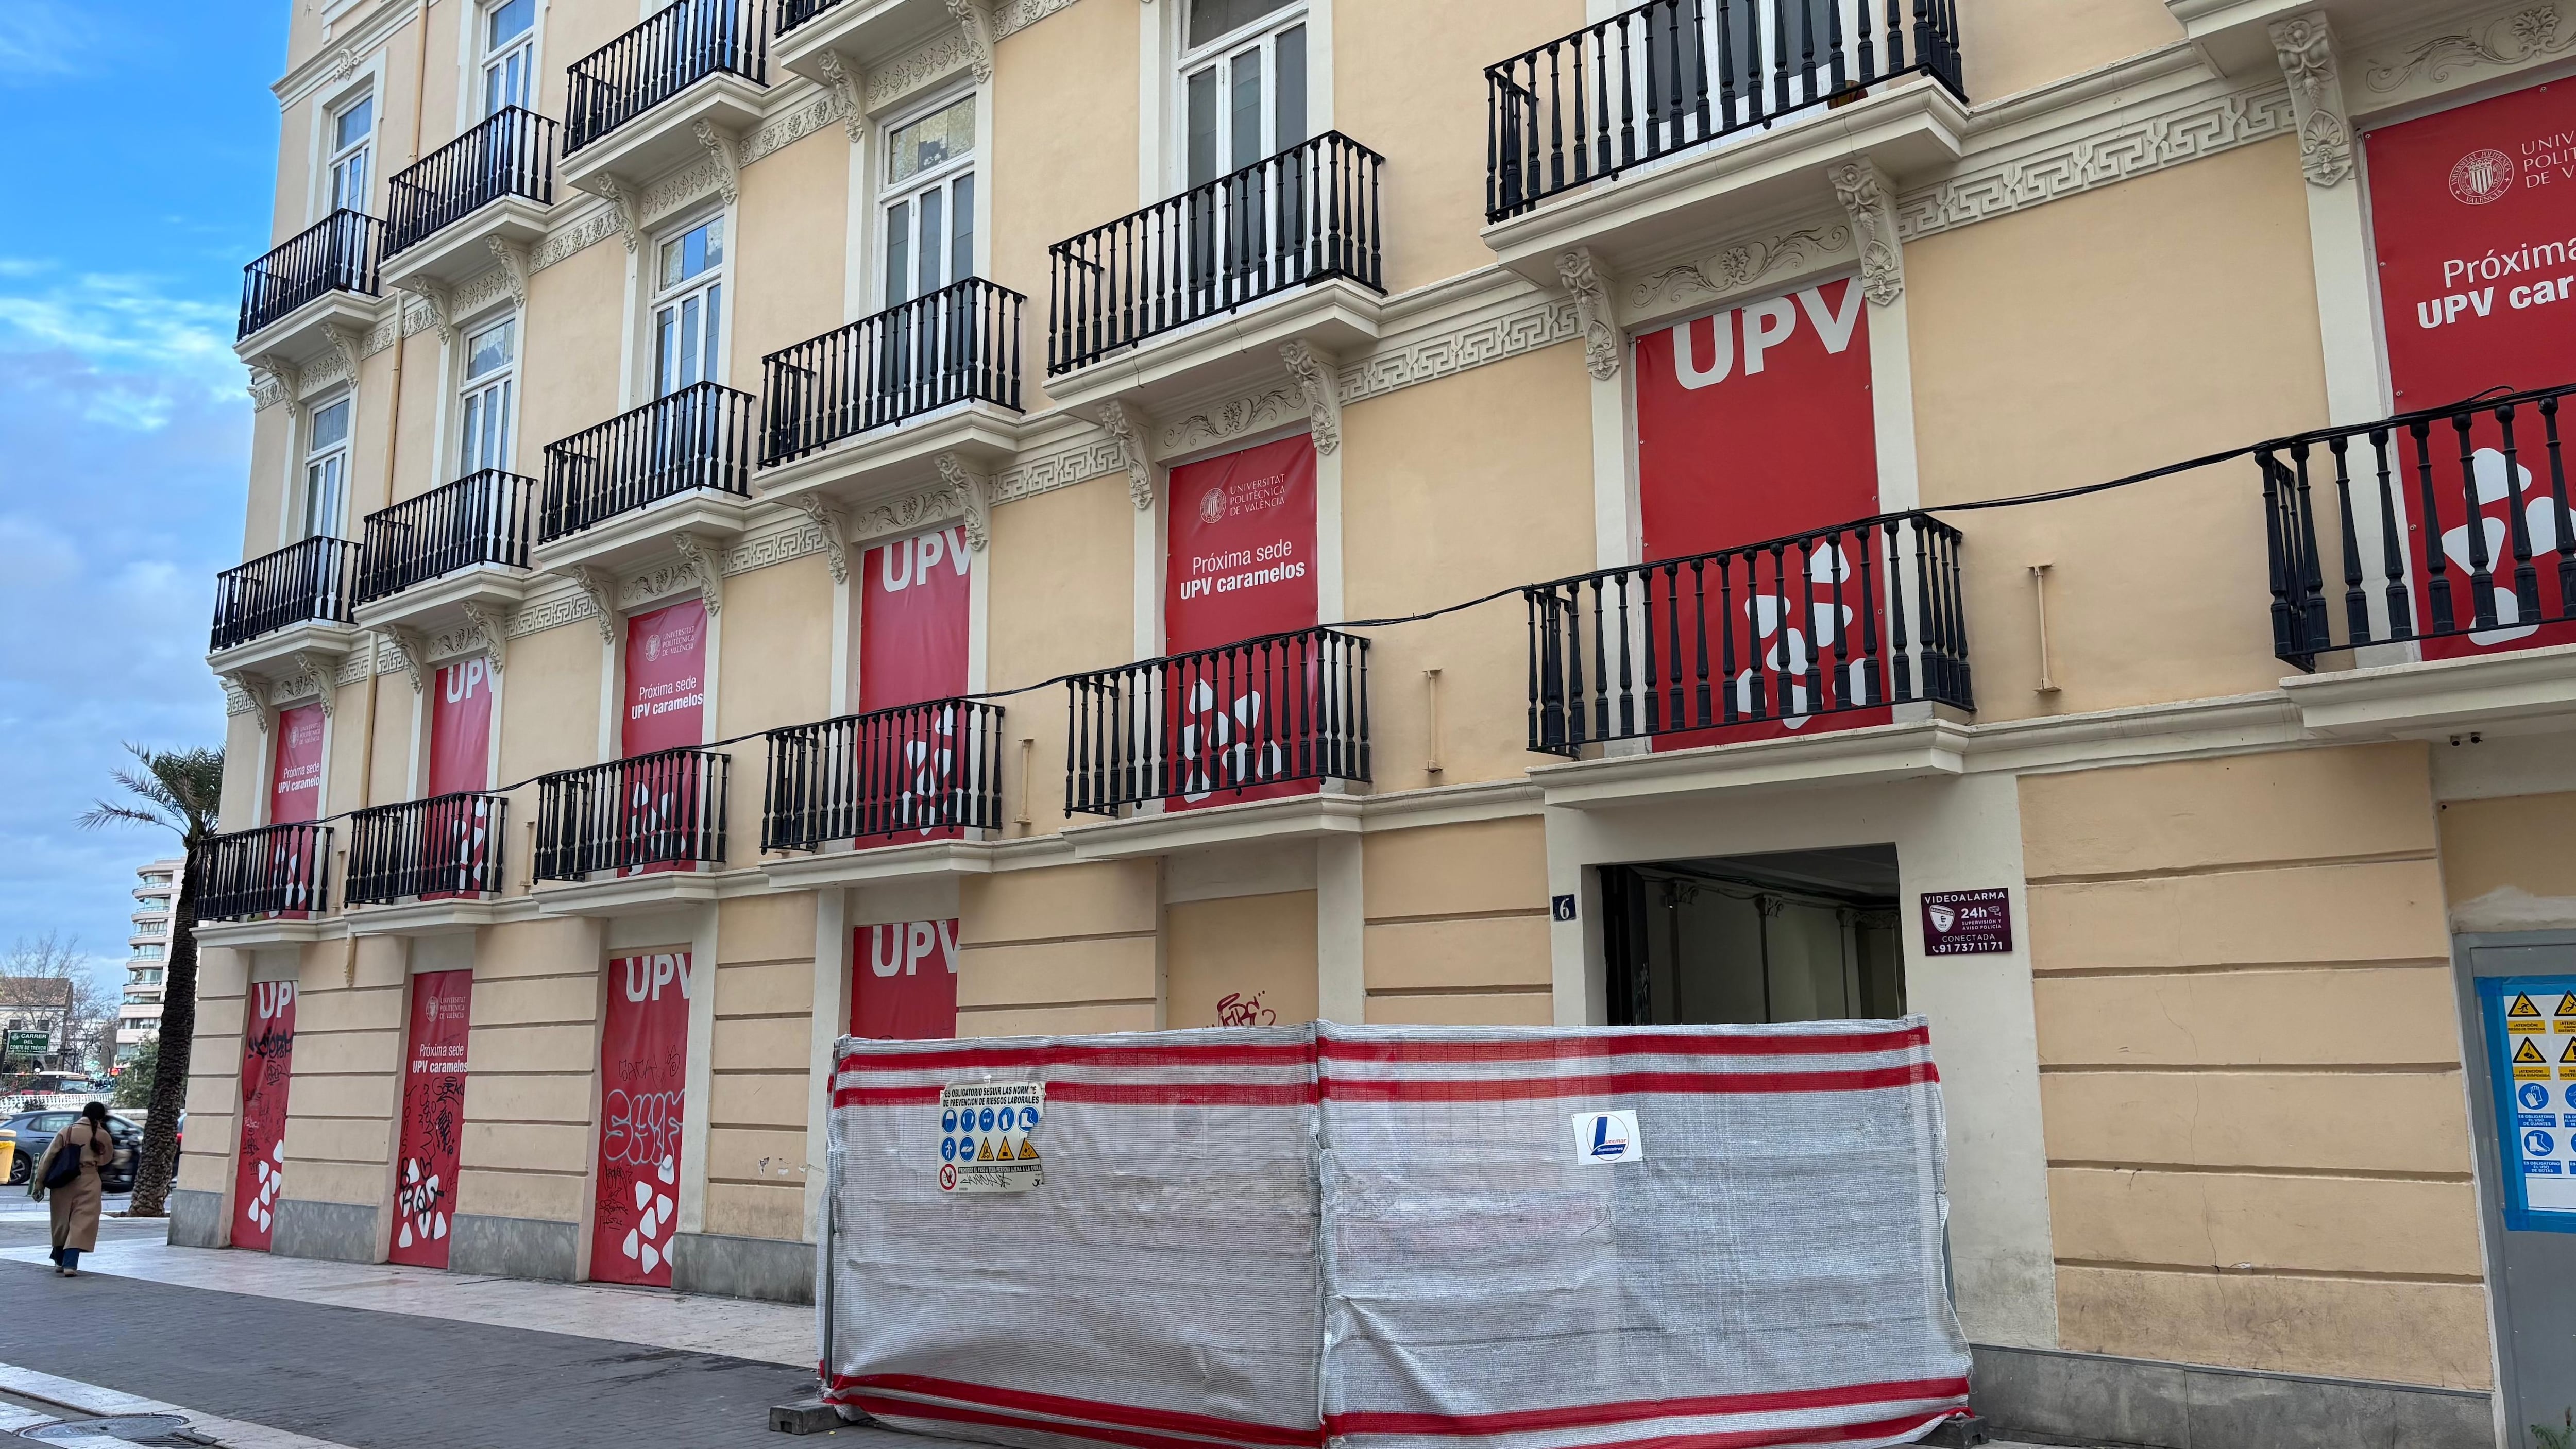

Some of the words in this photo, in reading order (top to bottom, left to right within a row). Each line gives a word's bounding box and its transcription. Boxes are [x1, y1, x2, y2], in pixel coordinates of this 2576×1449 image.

[2521, 130, 2574, 155] UNIV
[2526, 171, 2551, 189] DE
[2417, 286, 2494, 329] UPV
[2509, 275, 2574, 309] car
[1673, 278, 1865, 390] UPV
[1230, 473, 1285, 495] UNIVERSITAT
[1230, 485, 1285, 505] POLITÈCNICA
[1230, 506, 1240, 516] DE
[1245, 496, 1284, 513] VALÈNCIA
[883, 528, 971, 592] UPV
[1193, 550, 1251, 575] Próxima
[1256, 539, 1292, 561] sede
[1180, 577, 1212, 600] UPV
[1217, 561, 1305, 592] caramelos
[663, 626, 694, 640] UNIVERSITAT
[639, 683, 673, 701] Próxima
[675, 675, 697, 691] sede
[632, 703, 651, 720] UPV
[653, 693, 704, 715] caramelos
[284, 765, 305, 779] Próxima
[307, 761, 320, 774] sede
[278, 780, 291, 793] UPV
[1925, 891, 2005, 904] VIDEOALARMA
[1560, 898, 1569, 919] 6
[1961, 907, 1987, 919] 24h
[1939, 944, 1952, 953] 91
[1954, 943, 1974, 952] 737
[1978, 942, 1987, 951] 11
[1991, 942, 2003, 950] 71
[1942, 934, 1995, 942] CONECTADA
[872, 920, 961, 977] UPV
[259, 981, 298, 1019] UP
[419, 1043, 447, 1057] Próxima
[449, 1043, 464, 1056] sede
[413, 1060, 428, 1073] UPV
[943, 1099, 949, 1107] DE
[950, 1098, 978, 1107] PREVENCION
[979, 1097, 985, 1105] DE
[986, 1096, 1007, 1105] RIESGOS
[1008, 1096, 1039, 1104] LABORALES
[952, 1088, 982, 1097] OBLIGATORIO
[984, 1087, 1001, 1096] SEGUIR
[1002, 1086, 1012, 1095] LAS
